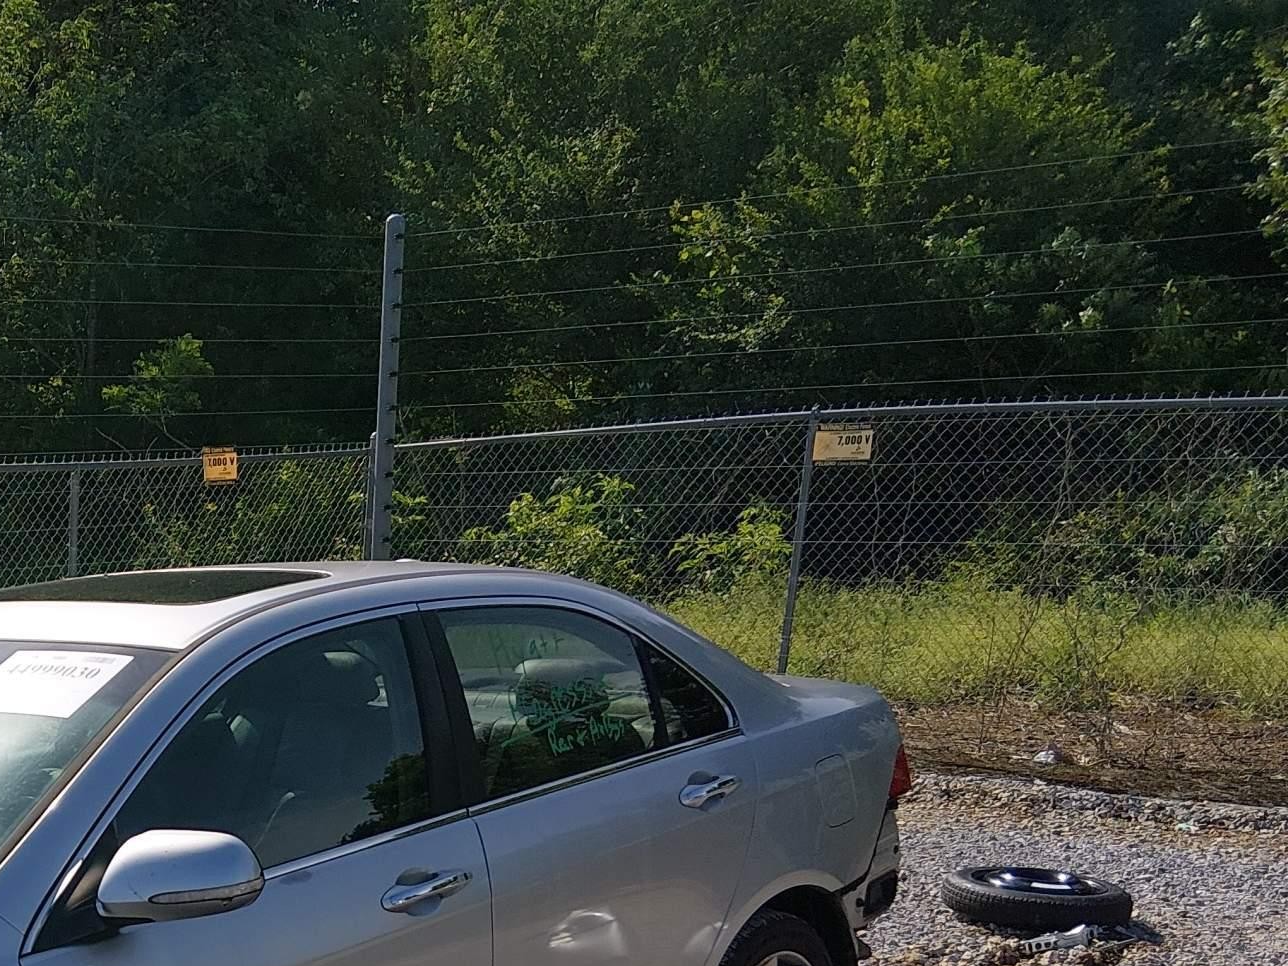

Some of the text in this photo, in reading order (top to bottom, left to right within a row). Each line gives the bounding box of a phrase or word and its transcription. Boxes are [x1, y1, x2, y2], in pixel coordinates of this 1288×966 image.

[837, 434, 871, 447] 7,000 V
[229, 456, 235, 466] V
